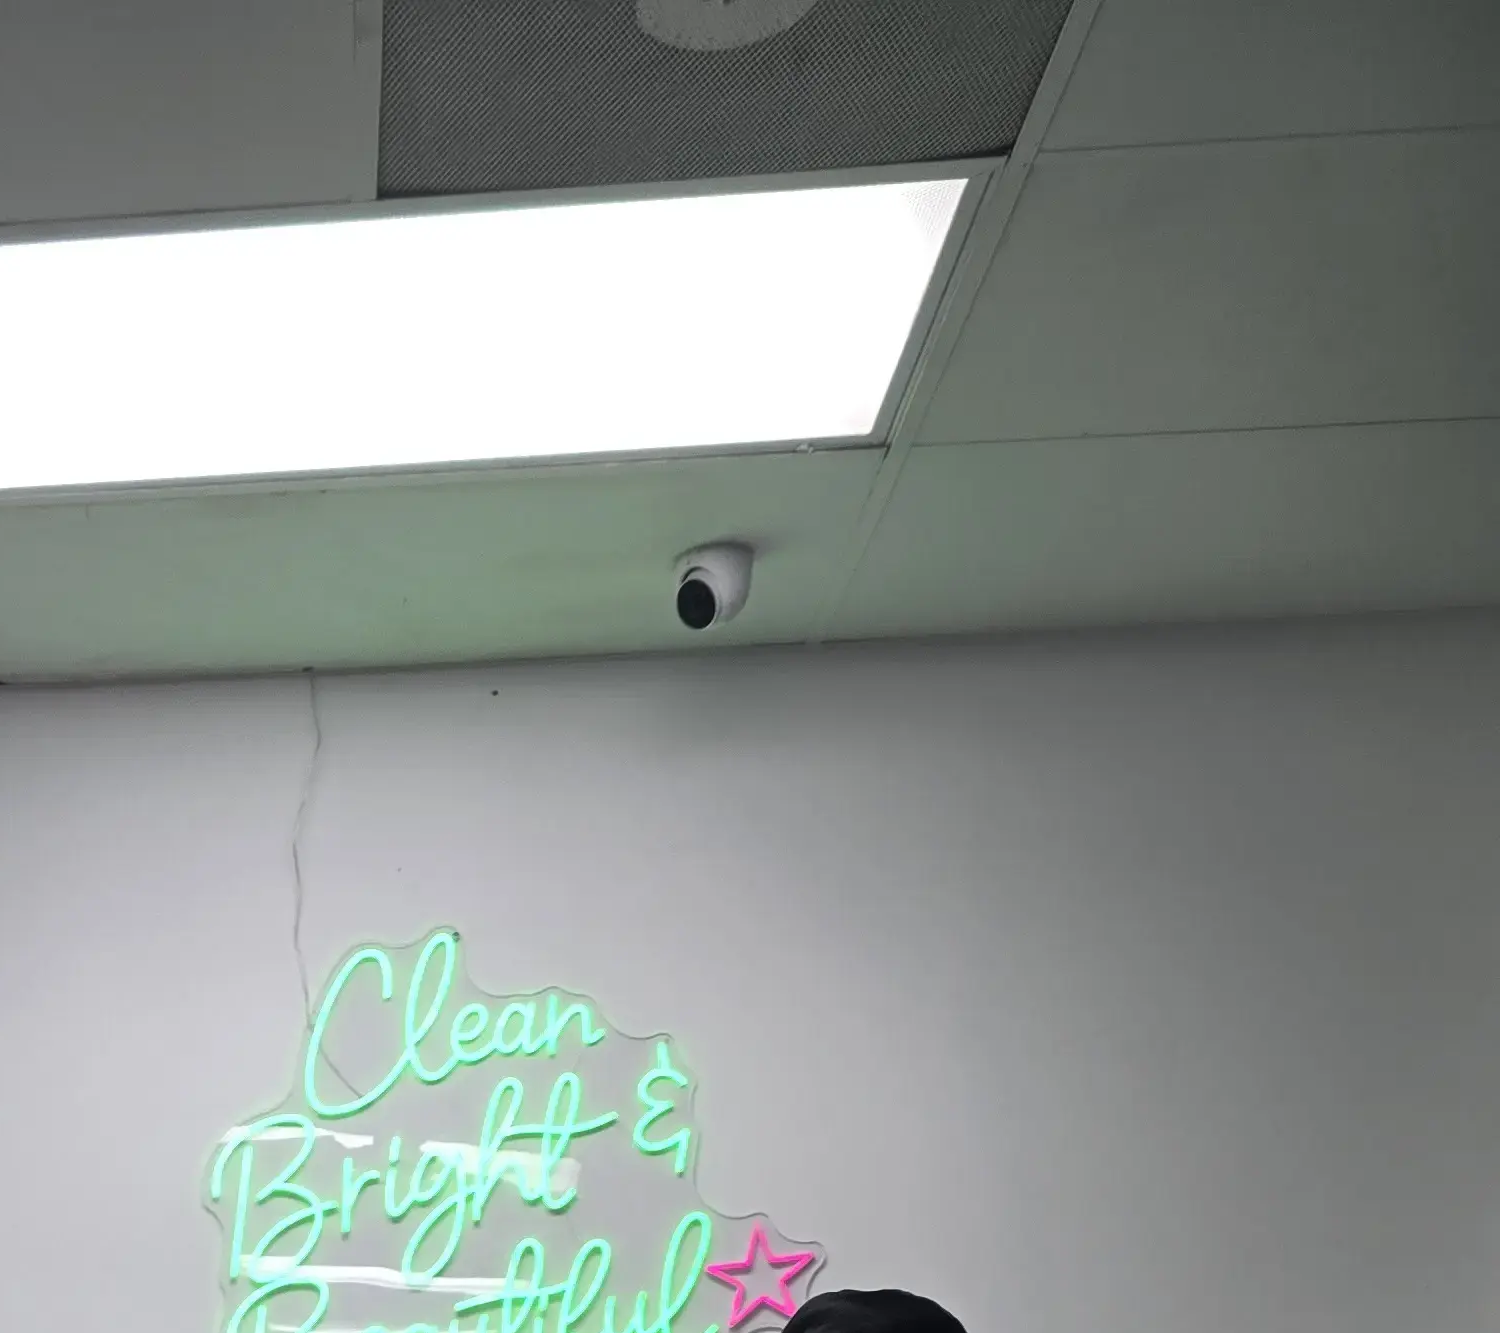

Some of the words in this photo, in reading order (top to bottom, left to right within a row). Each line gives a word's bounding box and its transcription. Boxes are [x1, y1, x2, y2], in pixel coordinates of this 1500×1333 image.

[304, 931, 608, 1118] Clean
[210, 1071, 620, 1287] Bright
[632, 1040, 691, 1174] &
